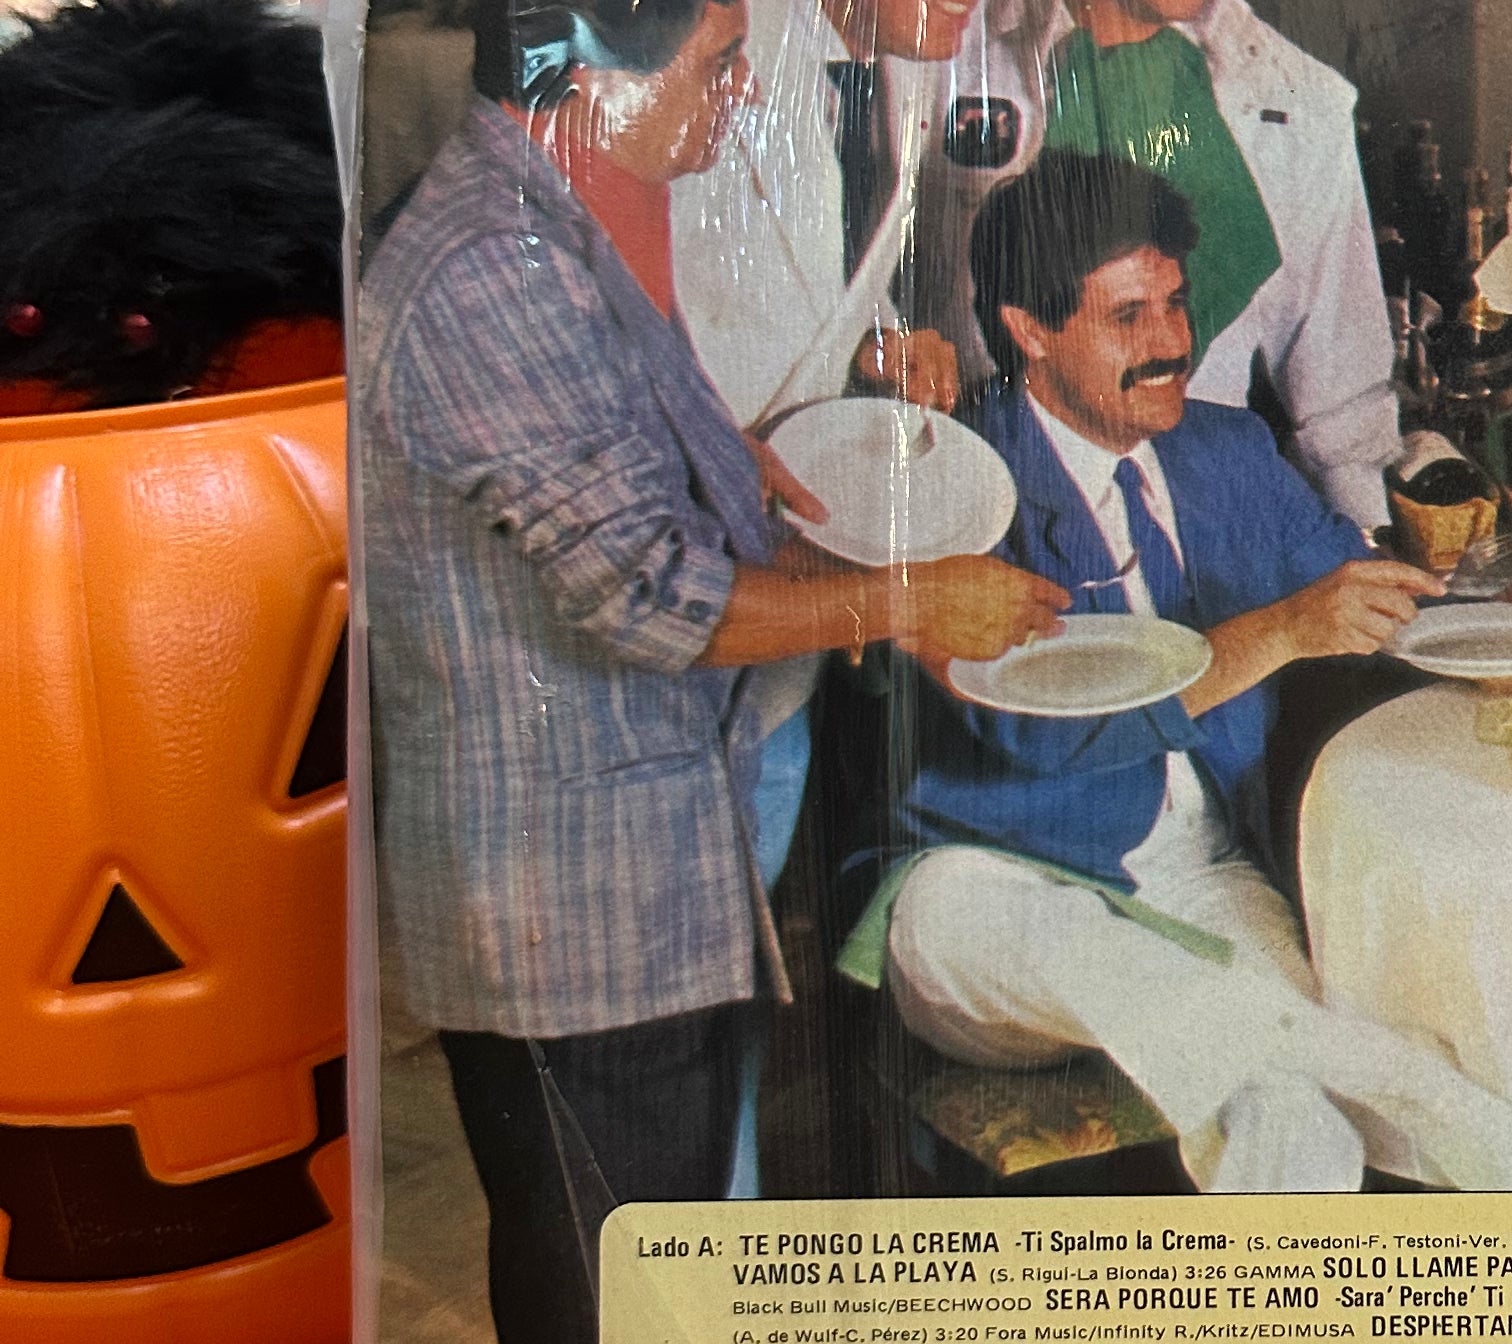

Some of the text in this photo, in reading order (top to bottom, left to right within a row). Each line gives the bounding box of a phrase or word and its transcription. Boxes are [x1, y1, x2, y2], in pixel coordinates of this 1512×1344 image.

[637, 1228, 1236, 1258] Lado A: TE PONGO LA CREMA -Ti Spalmo la Crema-
[732, 1260, 977, 1286] VAMOS A LA PLAYA
[1322, 1256, 1387, 1279] SOLO
[1396, 1255, 1479, 1279] LLAME
[1045, 1288, 1111, 1312] SERA
[1118, 1287, 1218, 1311] PORQUE
[1226, 1286, 1256, 1309] TE
[1264, 1286, 1319, 1309] AMO
[1482, 1284, 1504, 1308] Ti
